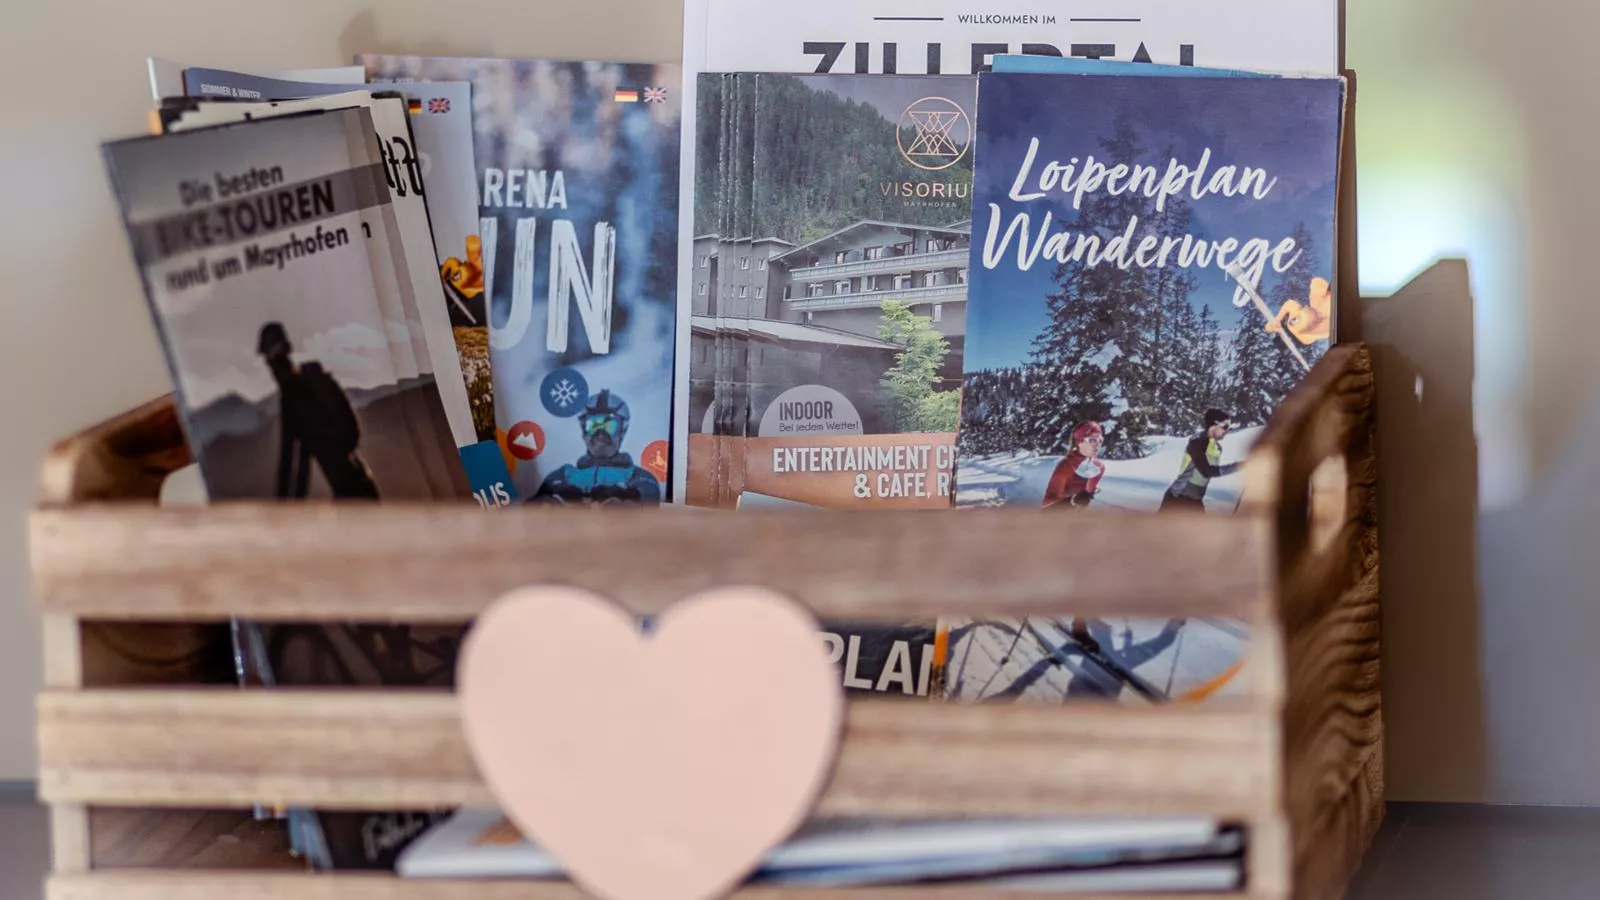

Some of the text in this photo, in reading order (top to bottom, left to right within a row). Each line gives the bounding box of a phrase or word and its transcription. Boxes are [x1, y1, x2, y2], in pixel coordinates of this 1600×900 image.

[957, 14, 1056, 24] WILLKOMMEN IM
[179, 164, 284, 207] Die besten
[1008, 136, 1277, 212] Loipenplan
[880, 182, 968, 198] VISORIU
[156, 178, 336, 257] BIKE-TOUREN
[167, 260, 210, 292] rund
[214, 257, 242, 281] um
[246, 225, 349, 270] Mayrhofen
[982, 202, 1303, 307] Wanderwege
[779, 401, 833, 420] INDOOR
[779, 422, 794, 432] Bei
[796, 422, 824, 432] jedem
[773, 445, 931, 473] ENTERTAINMENT
[854, 473, 872, 498] &
[877, 472, 932, 499] CAFE,
